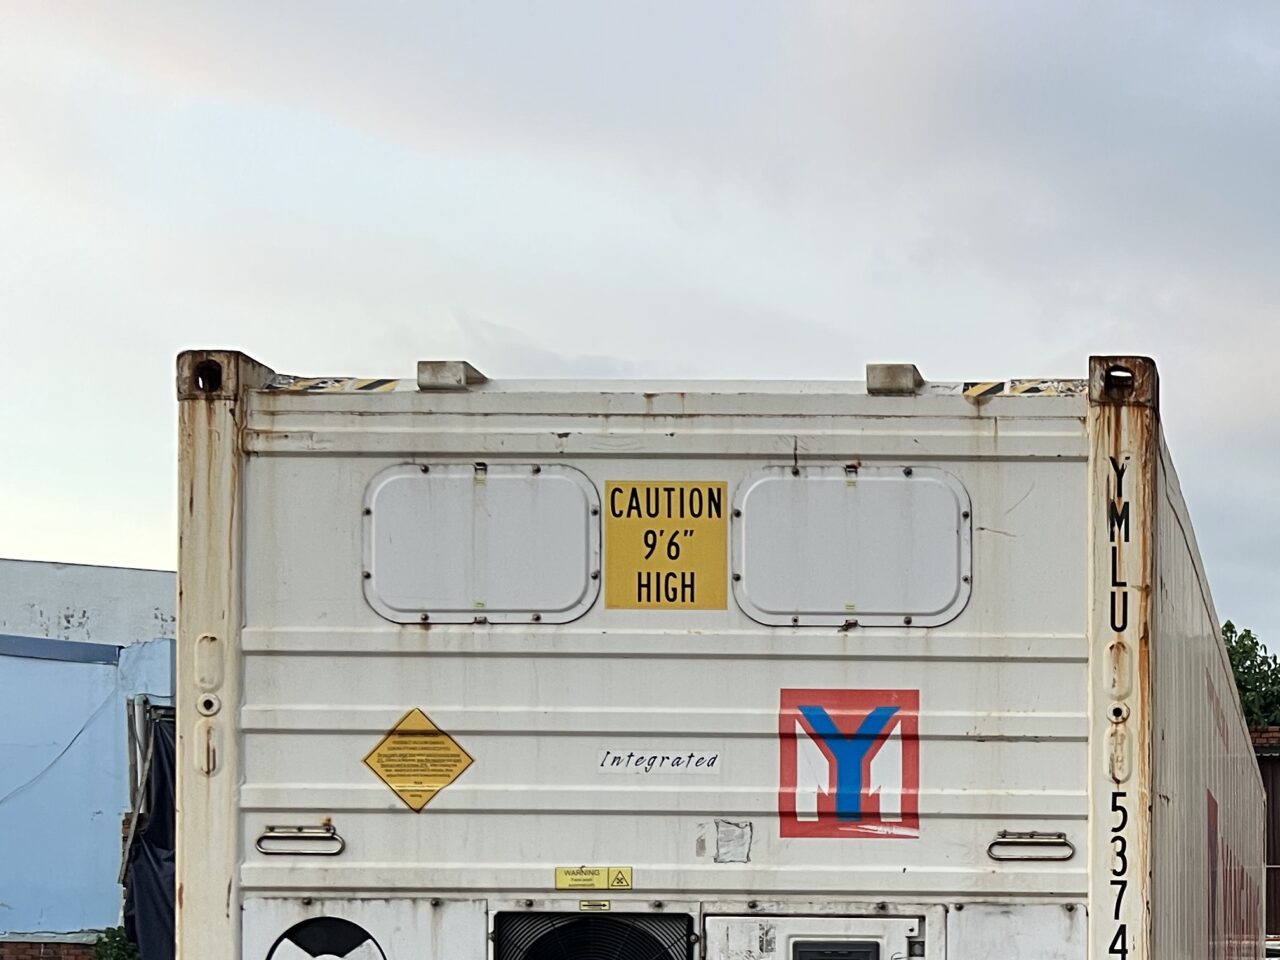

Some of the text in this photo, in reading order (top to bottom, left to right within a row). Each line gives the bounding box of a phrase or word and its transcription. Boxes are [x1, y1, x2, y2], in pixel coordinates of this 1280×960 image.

[610, 487, 722, 518] CAUTION
[643, 529, 694, 560] 9'6"
[1109, 457, 1130, 632] YMLU
[637, 571, 695, 603] HIGH
[600, 751, 719, 773] Integrated
